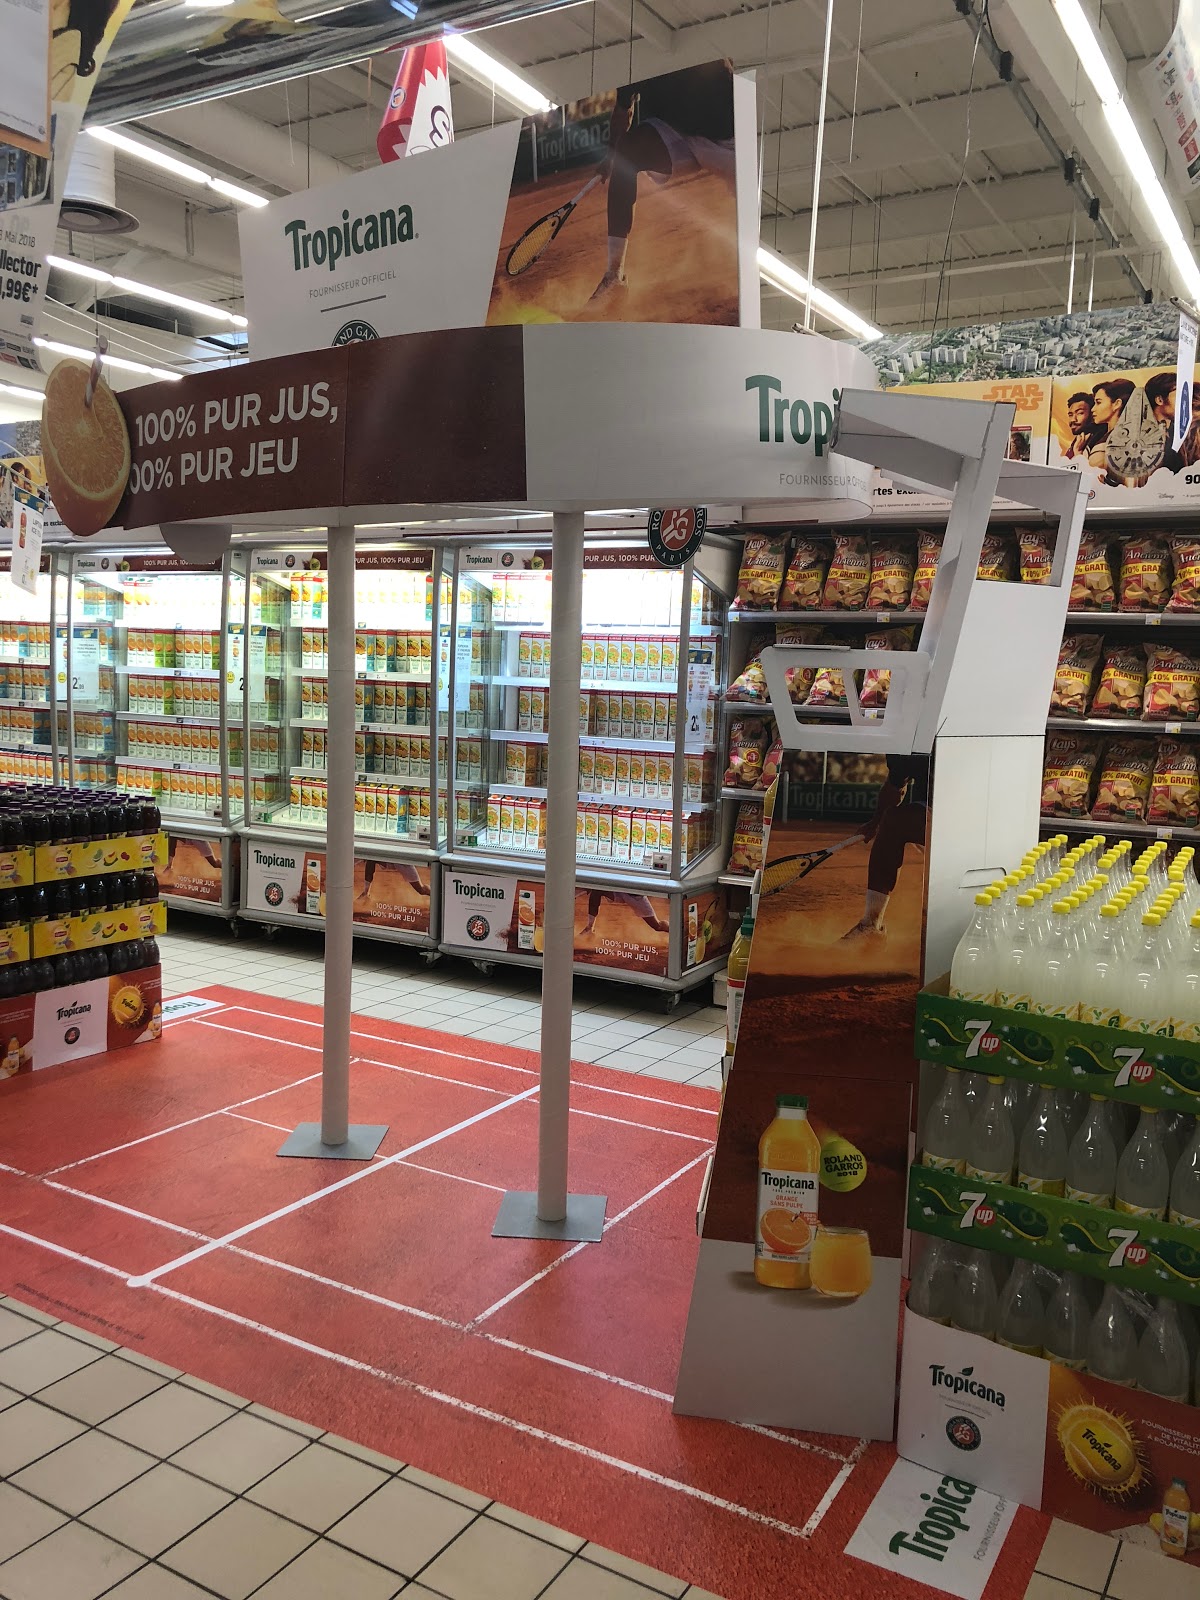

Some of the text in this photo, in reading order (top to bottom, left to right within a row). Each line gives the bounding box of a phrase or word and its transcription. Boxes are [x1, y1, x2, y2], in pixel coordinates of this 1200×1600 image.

[285, 204, 414, 271] Tropicana
[0, 249, 41, 278] llector
[309, 270, 396, 299] FOURNISSEUR OFFICIEL
[983, 384, 1043, 399] STAR
[135, 382, 338, 447] 100% PUR JUS,
[129, 437, 299, 495] 00% PUR JEU
[780, 474, 851, 487] FOURNISSEUR
[466, 554, 493, 564] Tropicana
[584, 554, 599, 562] PUR
[601, 555, 617, 563] JUS,
[618, 554, 638, 562] 100%
[656, 543, 691, 562] PARIS
[257, 557, 279, 566] Tropicana
[366, 557, 379, 565] JUS,
[751, 570, 777, 580] GRATUIT
[883, 570, 910, 578] GRATUIT
[1057, 671, 1086, 681] GRATUIT
[1060, 771, 1089, 780] GRATUIT
[1116, 772, 1145, 786] GRATUIT
[254, 850, 296, 868] Tropicana
[453, 879, 505, 899] Tropicana
[370, 910, 387, 919] 100%
[388, 912, 401, 921] PUR
[376, 902, 423, 917] 100% PUR JUS,
[595, 946, 650, 962] 100% PUR JEU
[602, 938, 659, 956] 100% PUR JUS,
[57, 1003, 92, 1020] Tropicana
[824, 1154, 862, 1165] ROLAND
[825, 1162, 864, 1174] GARROS
[761, 1172, 814, 1190] Tropicana
[770, 1200, 785, 1208] SANS
[776, 1195, 799, 1203] ORANGE
[929, 1364, 1006, 1408] Tropicana
[1142, 1419, 1192, 1440] FOURNISSEUR
[1161, 1432, 1172, 1440] DE
[1082, 1428, 1121, 1471] Tropicana
[889, 1476, 978, 1562] Tropica
